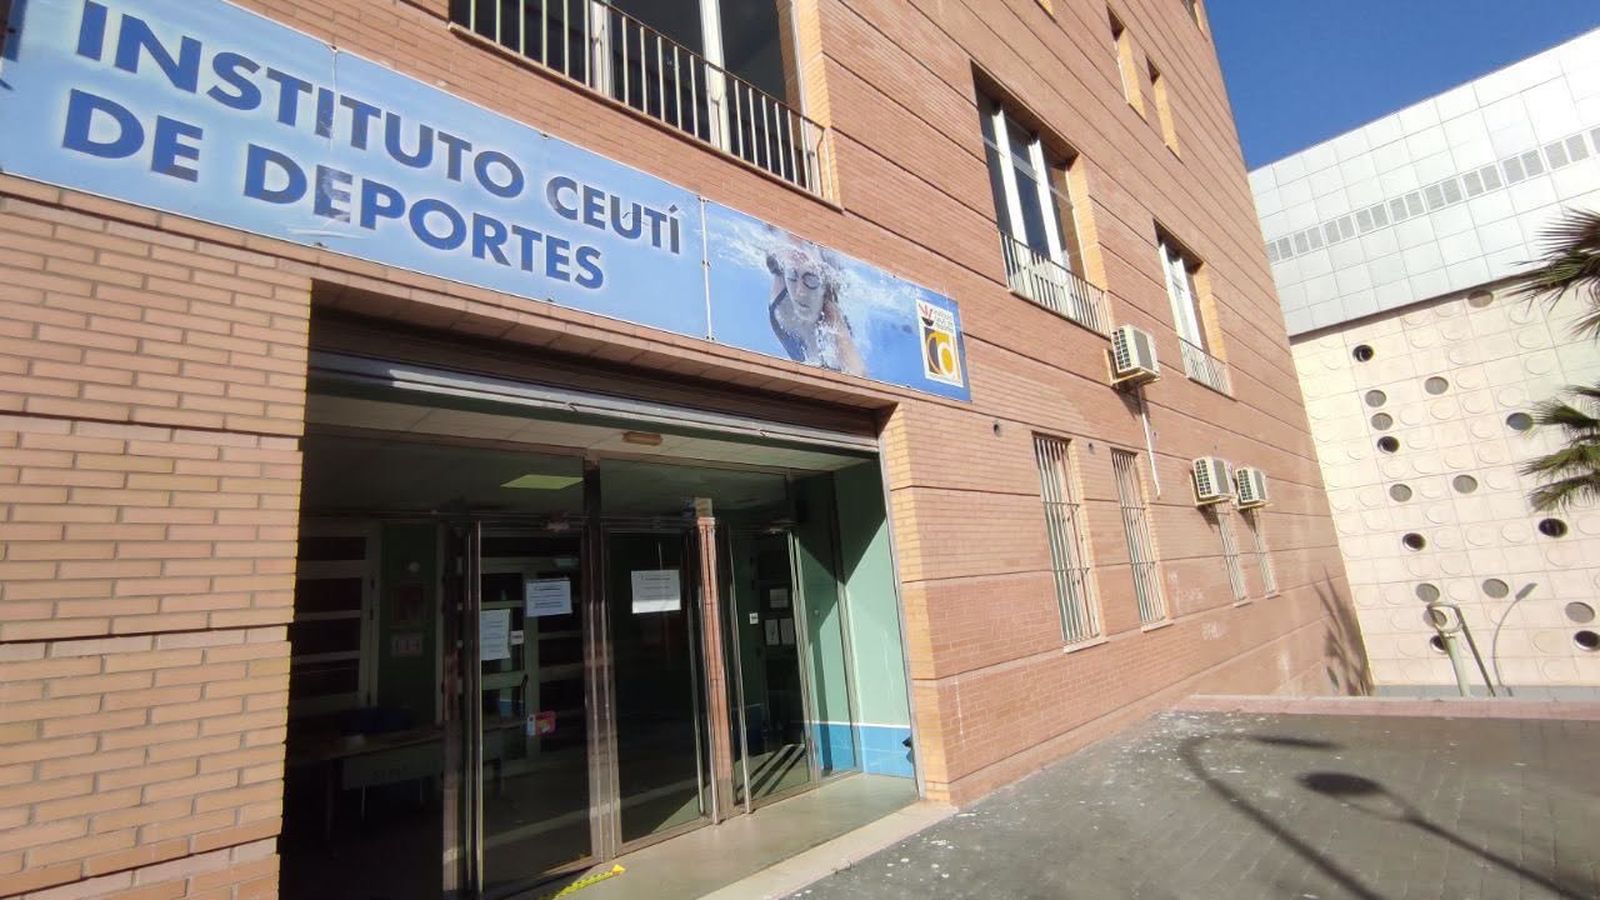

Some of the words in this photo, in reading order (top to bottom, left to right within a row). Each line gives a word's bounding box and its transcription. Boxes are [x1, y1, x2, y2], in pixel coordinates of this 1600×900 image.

[62, 88, 203, 182] DE
[243, 143, 604, 289] DEPORTES
[76, 0, 524, 198] INSTITUTO
[546, 176, 680, 254] CEUTÍ
